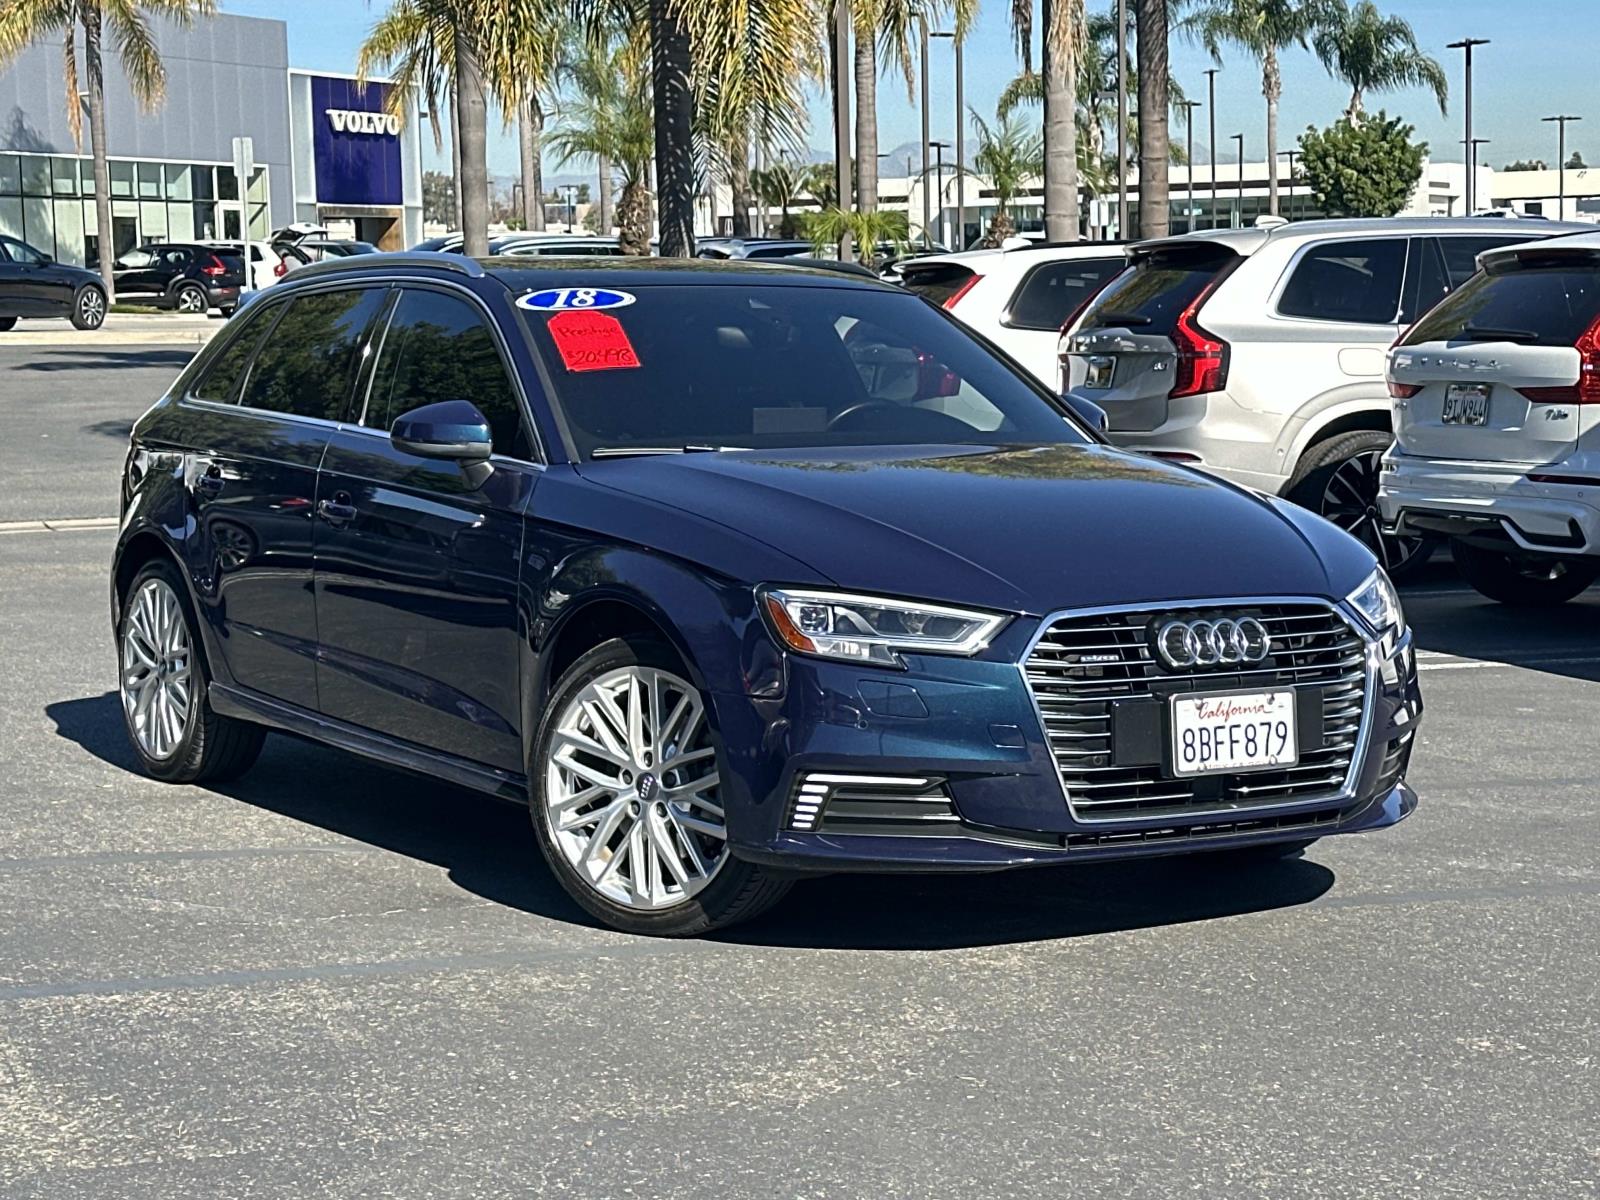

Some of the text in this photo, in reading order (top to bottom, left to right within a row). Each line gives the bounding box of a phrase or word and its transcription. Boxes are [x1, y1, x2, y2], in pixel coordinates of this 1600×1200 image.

[325, 109, 400, 136] VOLVO
[548, 288, 597, 309] 18
[1199, 700, 1274, 722] California
[1183, 720, 1288, 763] 8BFF879
